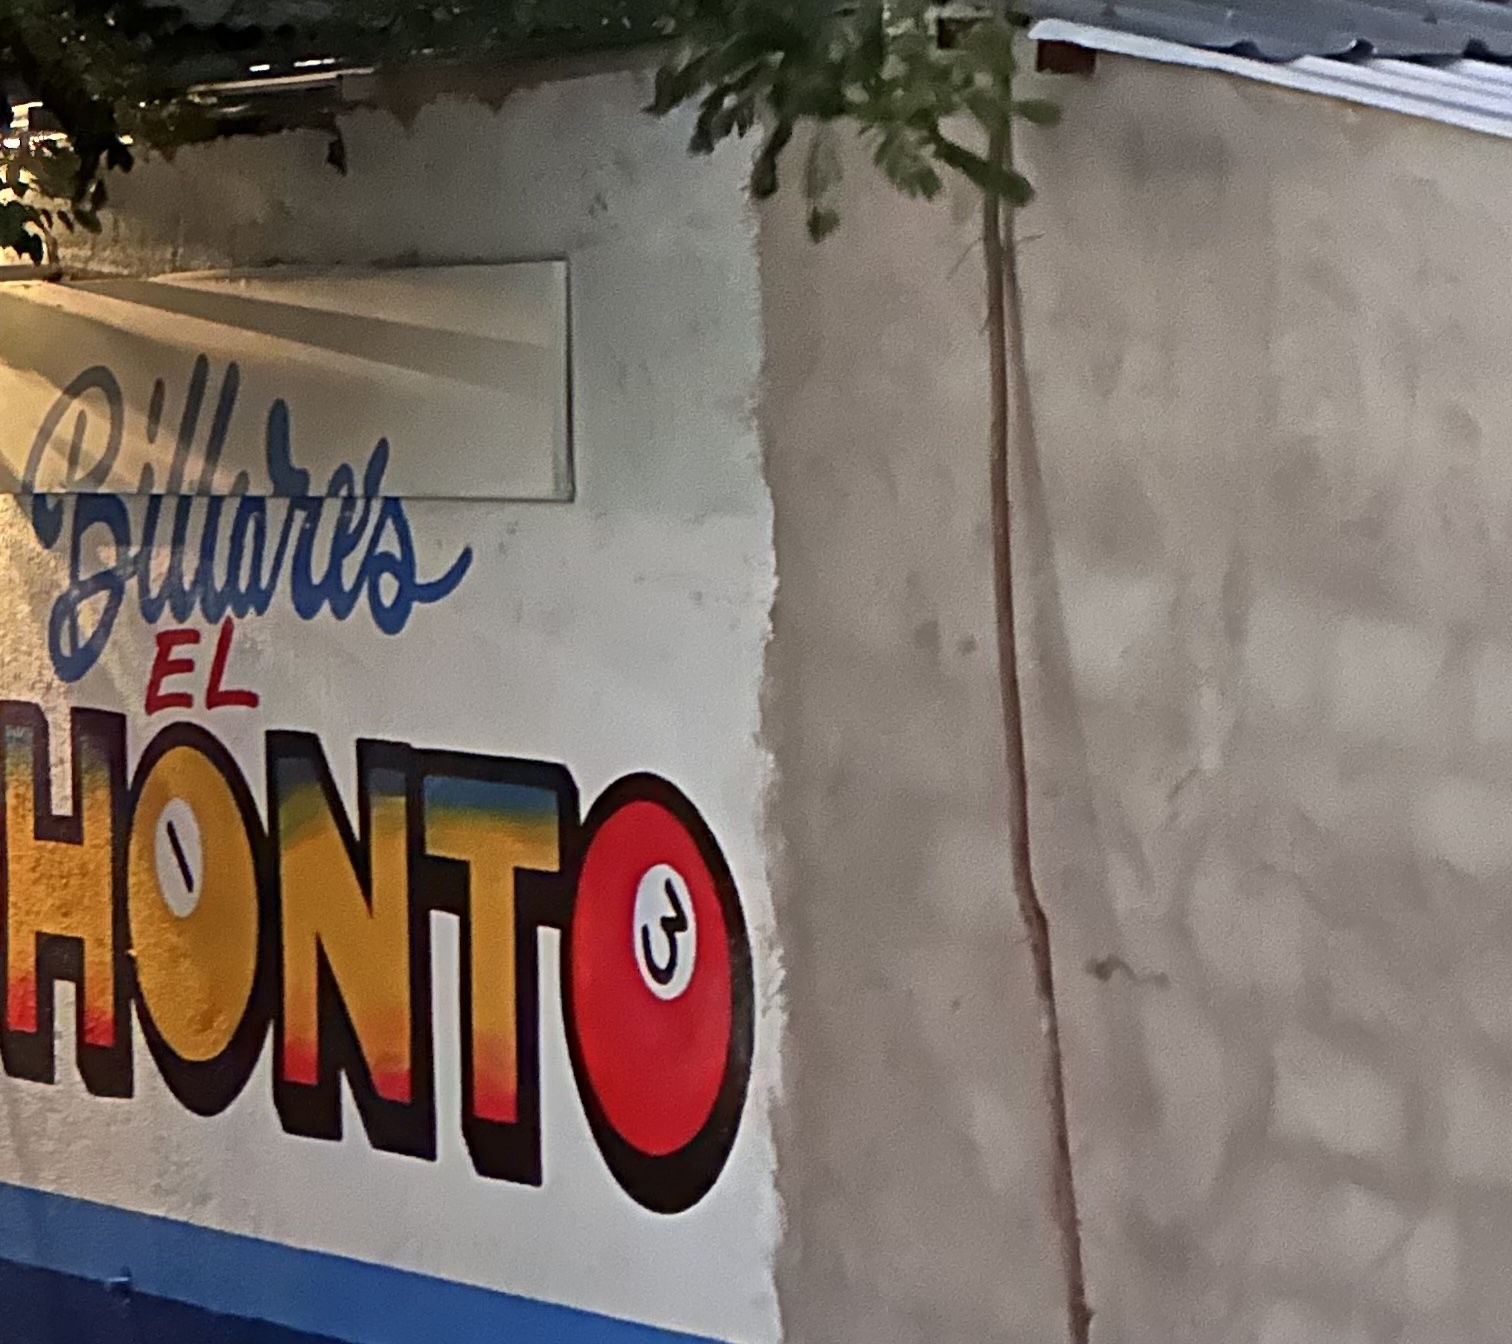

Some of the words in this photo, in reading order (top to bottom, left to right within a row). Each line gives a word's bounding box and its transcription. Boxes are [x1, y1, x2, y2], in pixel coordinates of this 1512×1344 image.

[24, 353, 473, 683] Billares
[144, 616, 259, 714] EL
[641, 877, 688, 986] 3
